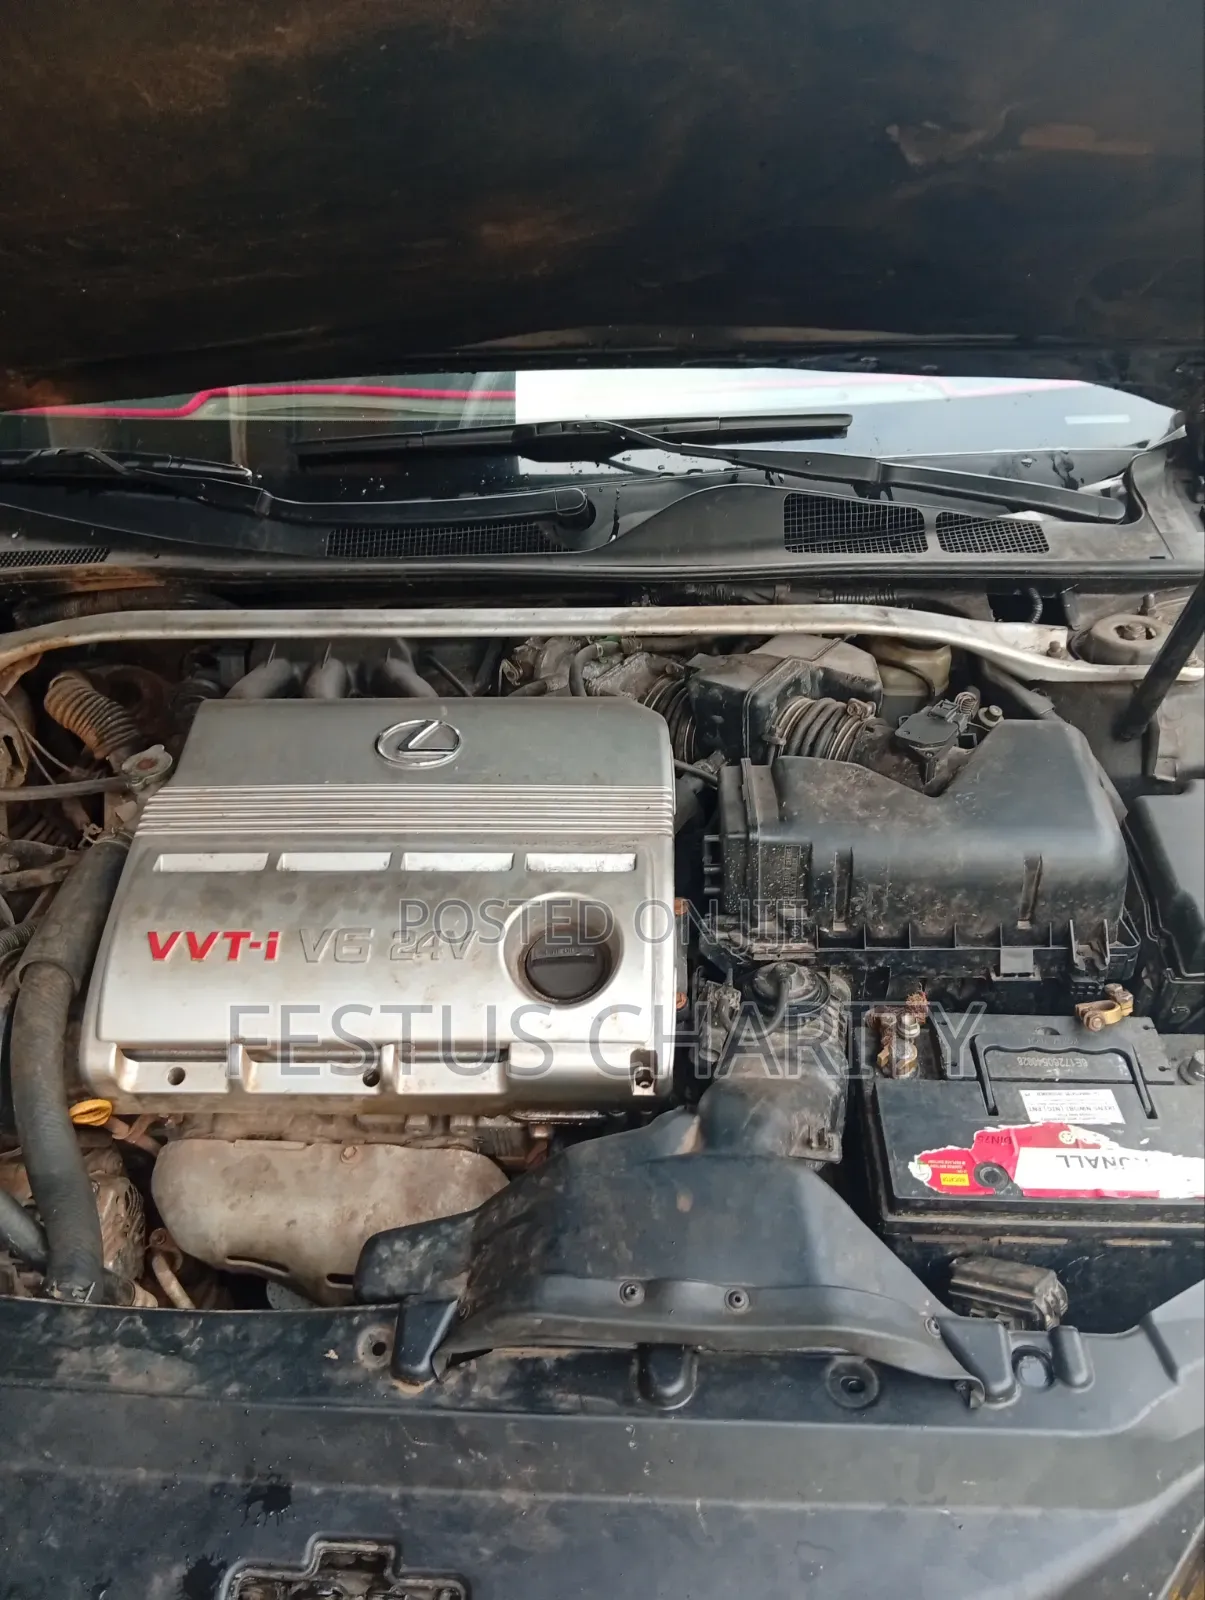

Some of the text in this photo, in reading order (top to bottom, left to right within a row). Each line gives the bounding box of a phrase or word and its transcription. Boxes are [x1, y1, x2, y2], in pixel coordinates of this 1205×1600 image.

[148, 928, 477, 963] VVT-i V6 24V
